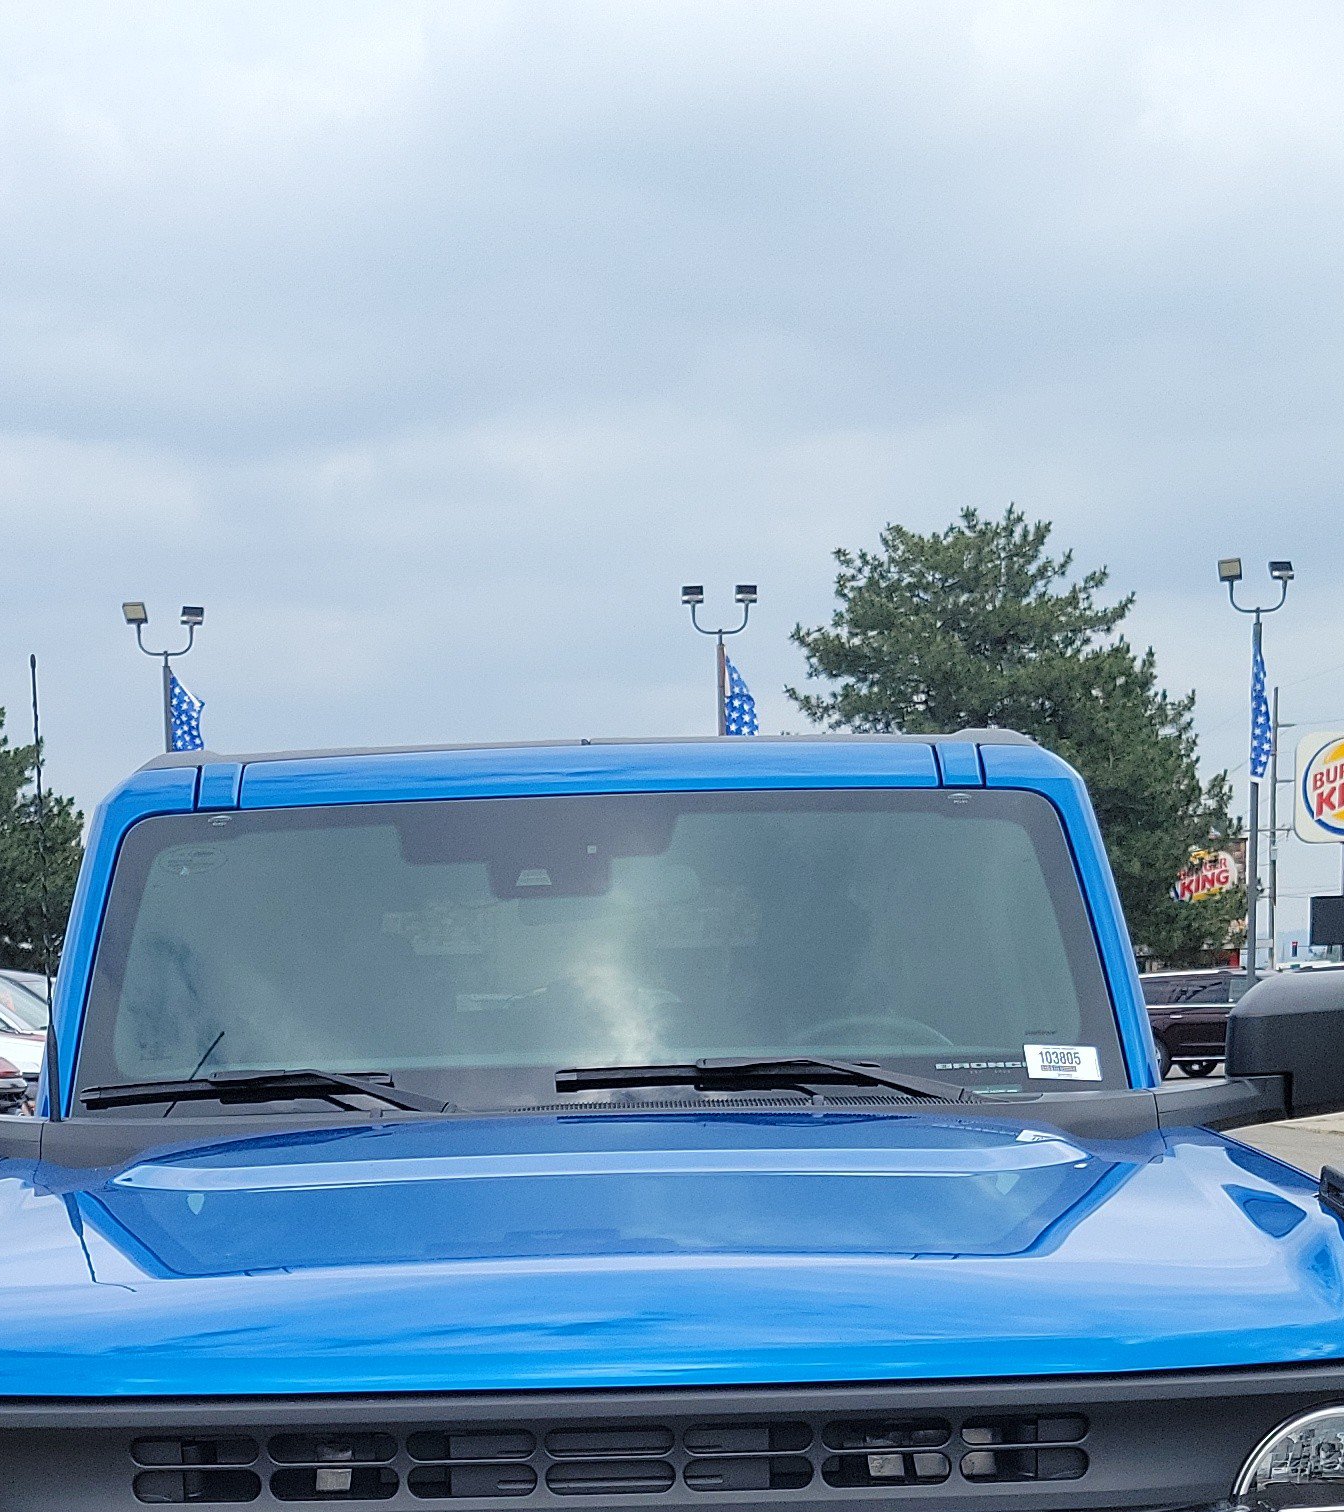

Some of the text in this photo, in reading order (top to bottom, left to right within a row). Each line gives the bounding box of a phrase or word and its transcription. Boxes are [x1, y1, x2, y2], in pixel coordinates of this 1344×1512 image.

[1180, 869, 1229, 898] KING
[1039, 1051, 1081, 1065] 103805
[935, 1061, 1027, 1070] BRONC
